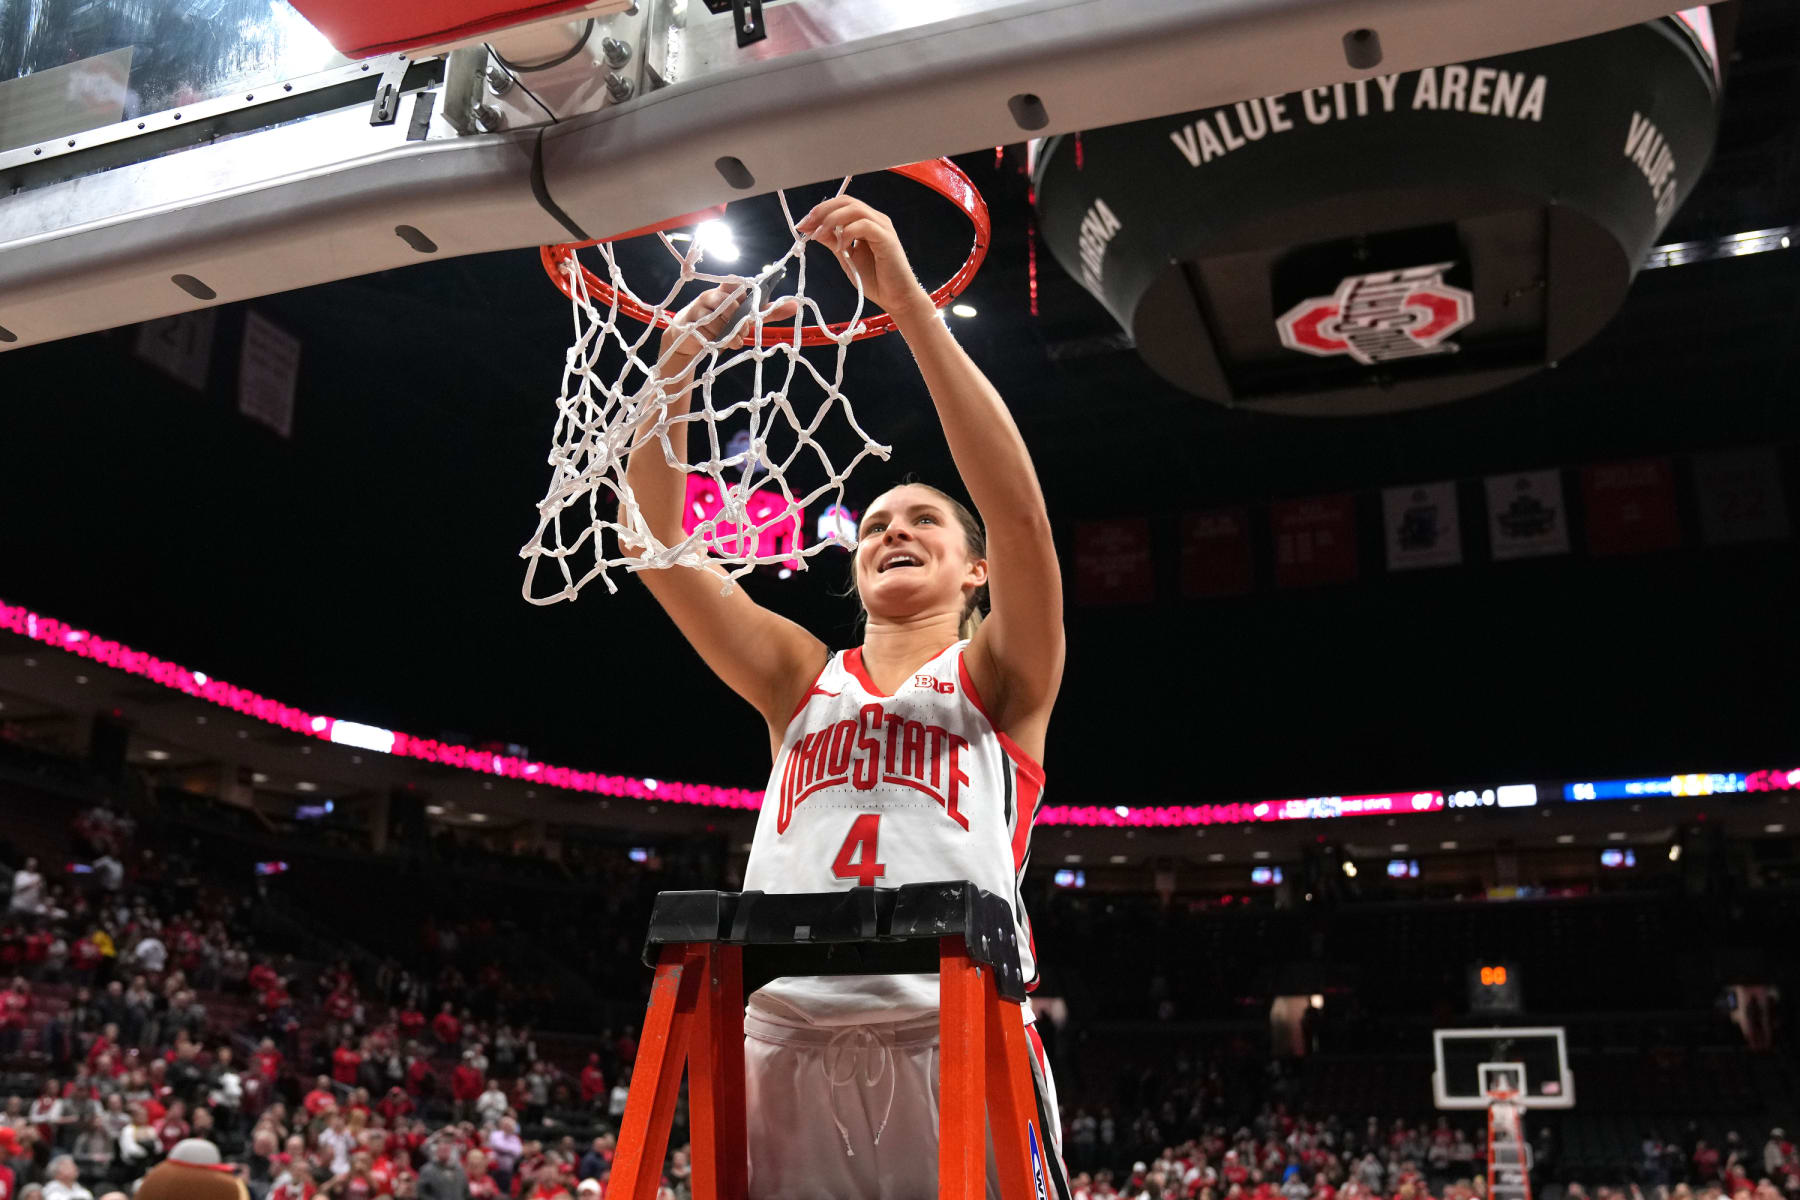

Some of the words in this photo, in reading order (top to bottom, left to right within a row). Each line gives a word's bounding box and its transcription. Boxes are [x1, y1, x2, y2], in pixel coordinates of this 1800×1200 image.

[1170, 95, 1294, 168] VALUE
[1302, 73, 1401, 125] CITY
[1412, 65, 1548, 122] ARENA
[831, 813, 886, 887] 4
